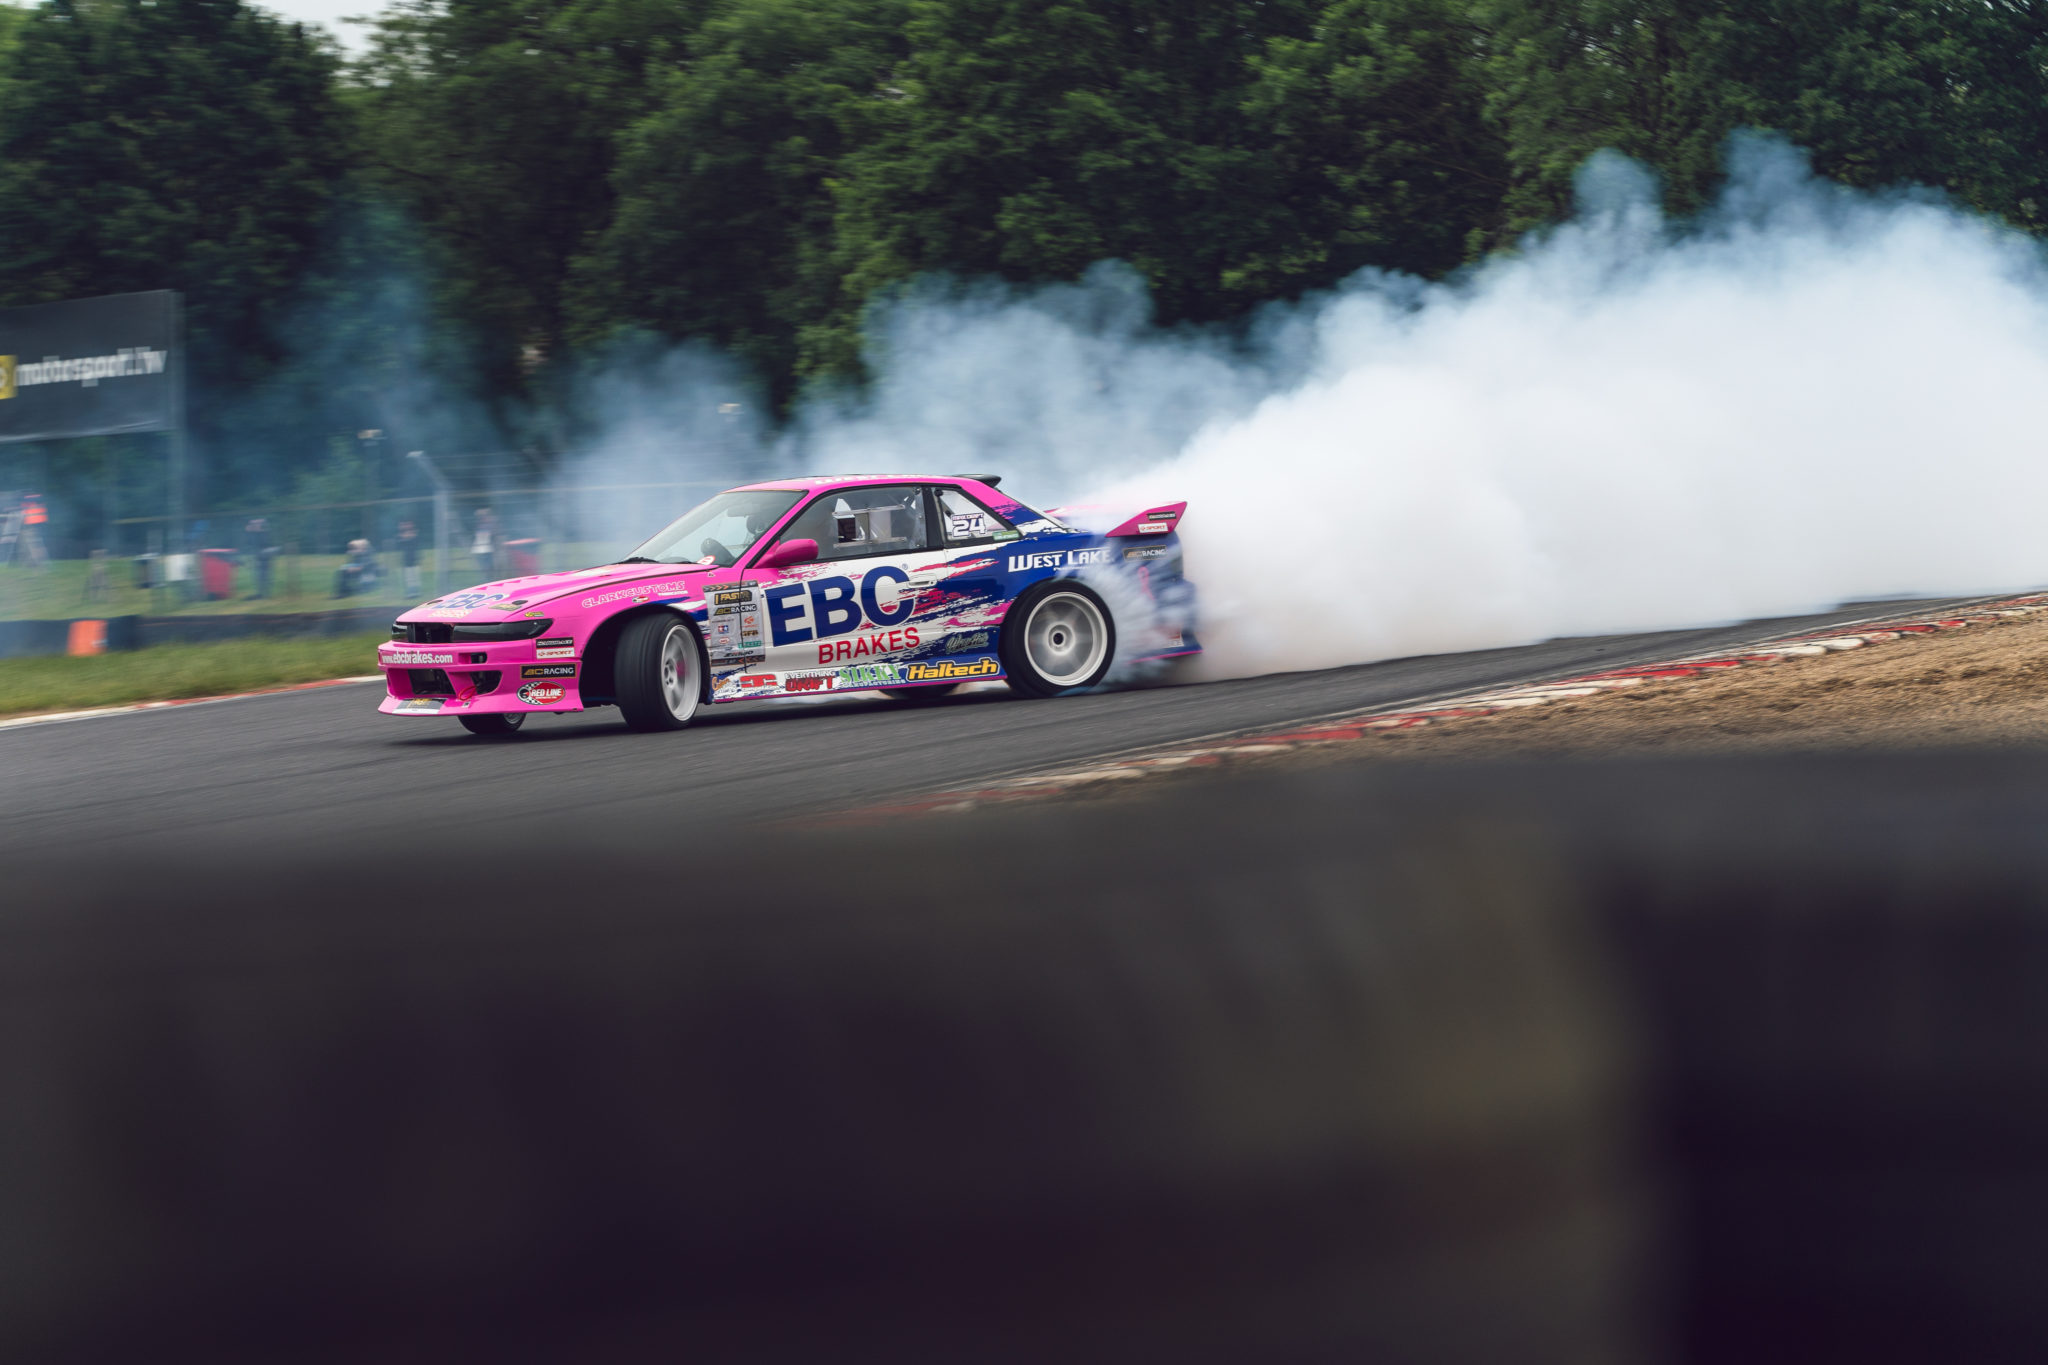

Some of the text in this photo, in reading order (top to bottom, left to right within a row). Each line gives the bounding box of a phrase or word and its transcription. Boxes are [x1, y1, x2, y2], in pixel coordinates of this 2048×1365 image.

[953, 517, 987, 537] 24
[1008, 547, 1111, 572] WEST LAKE
[432, 594, 505, 609] EBC
[764, 566, 916, 647] EBC
[818, 627, 920, 664] BRAKES
[382, 651, 453, 664] www.ebcbrakes.com
[785, 670, 835, 680] EVERYTHING
[839, 664, 900, 682] SIKKY
[908, 658, 999, 681] Haltech
[546, 688, 562, 696] LINE
[785, 676, 835, 692] DRIFT
